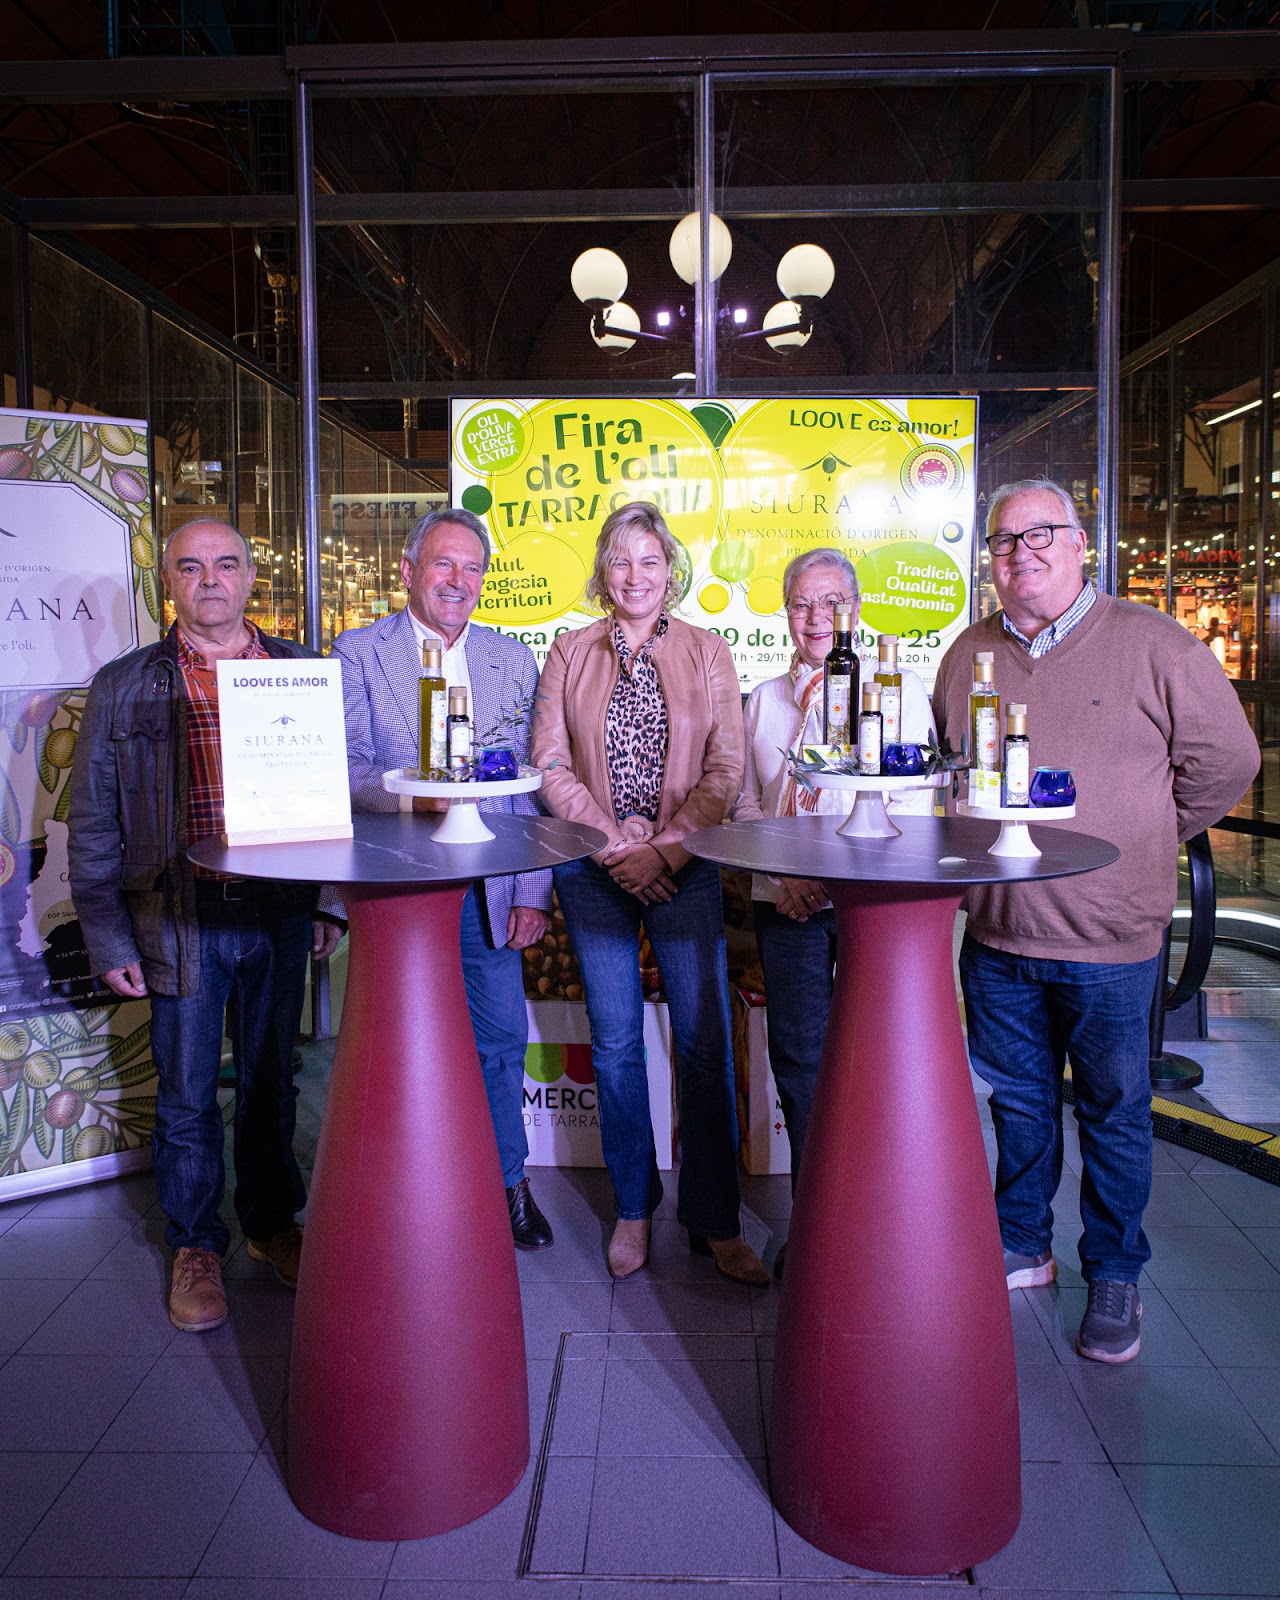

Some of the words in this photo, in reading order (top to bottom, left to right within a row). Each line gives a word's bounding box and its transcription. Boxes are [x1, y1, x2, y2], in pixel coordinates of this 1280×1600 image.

[477, 413, 500, 429] OLI
[554, 413, 643, 450] Fira
[790, 410, 863, 430] LOOVE
[898, 419, 959, 437] amor!
[467, 421, 517, 445] D'OLIVA
[474, 432, 516, 453] VERGE
[477, 444, 520, 466] EXTRA
[526, 454, 582, 492] de
[594, 444, 678, 485] l'oli
[750, 494, 903, 515] SIURAA
[737, 526, 842, 540] DENOMINACIÓ
[847, 527, 919, 540] D'ORIGEN
[485, 557, 525, 573] alut
[1128, 550, 1167, 563] ASA
[4, 565, 51, 573] D'ORIGEN
[895, 560, 960, 582] Tradició
[482, 574, 548, 595] agesia
[886, 576, 957, 597] Qualitat
[6, 597, 95, 621] ANA
[861, 591, 955, 613] astronomia
[11, 639, 36, 651] l'oli.
[747, 628, 775, 647] de
[906, 654, 920, 663] 20
[923, 654, 930, 663] h
[233, 677, 274, 688] LOOVE
[291, 677, 329, 687] AMOR
[244, 734, 325, 747] SIURANA
[62, 910, 77, 918] Siura
[522, 1087, 599, 1110] MERC
[522, 1113, 541, 1127] DE
[547, 1114, 600, 1128] TARRA
